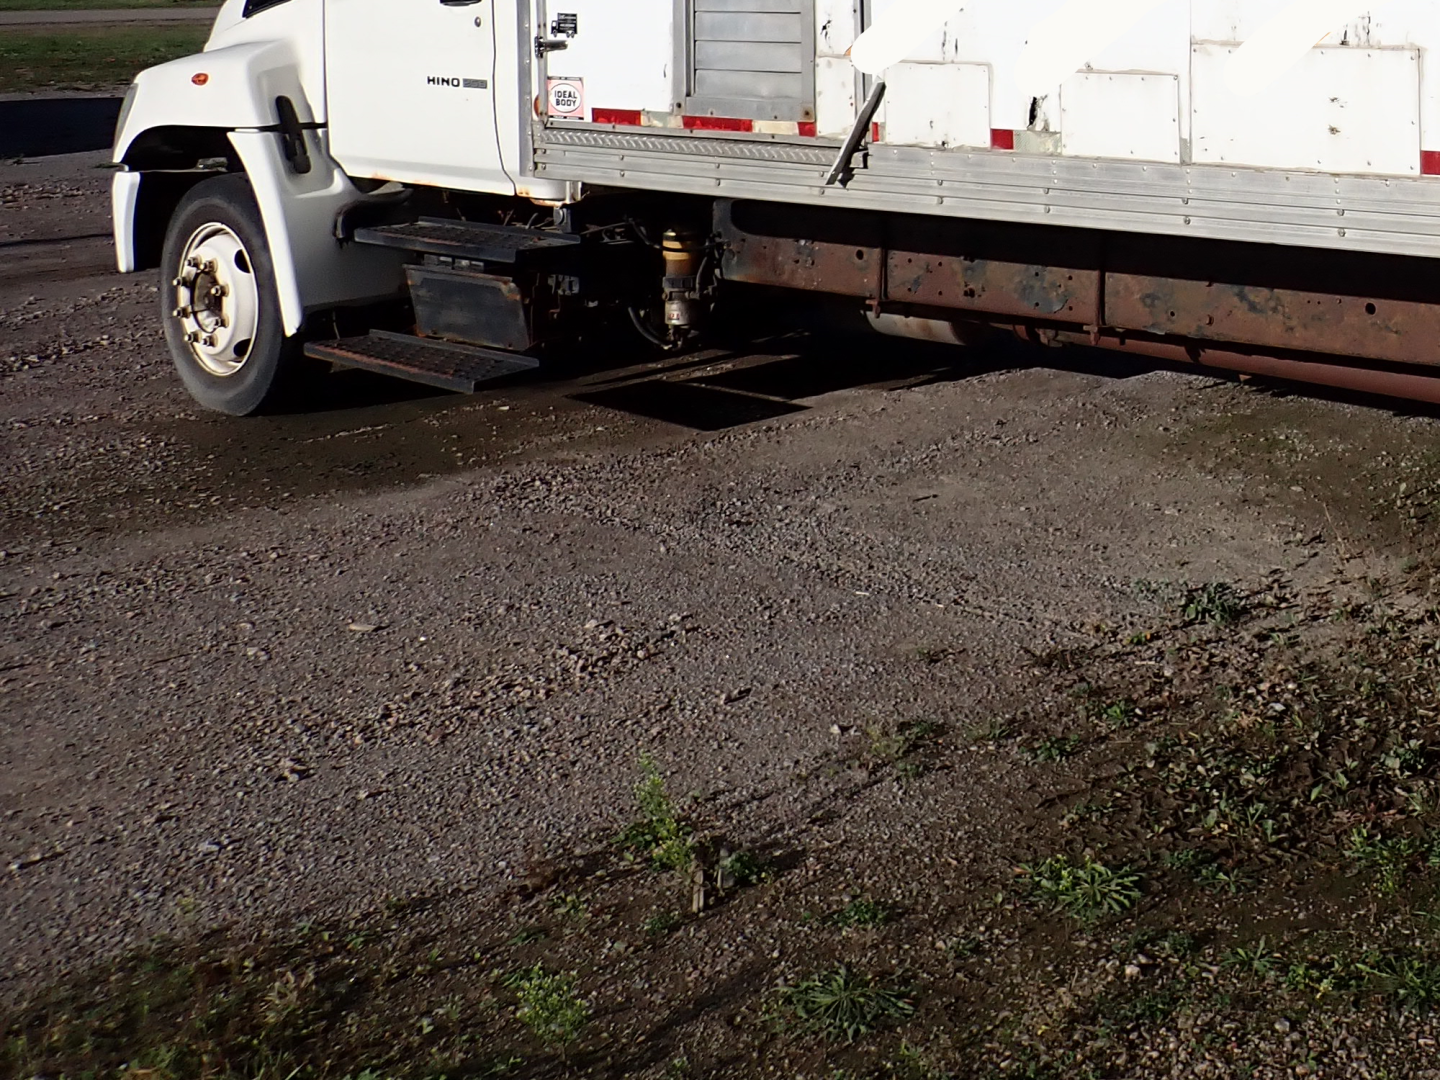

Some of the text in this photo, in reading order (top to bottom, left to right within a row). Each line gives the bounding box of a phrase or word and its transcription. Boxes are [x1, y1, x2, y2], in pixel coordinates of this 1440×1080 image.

[427, 76, 460, 87] HINO
[554, 90, 577, 99] IDEAL
[556, 98, 577, 107] BODY
